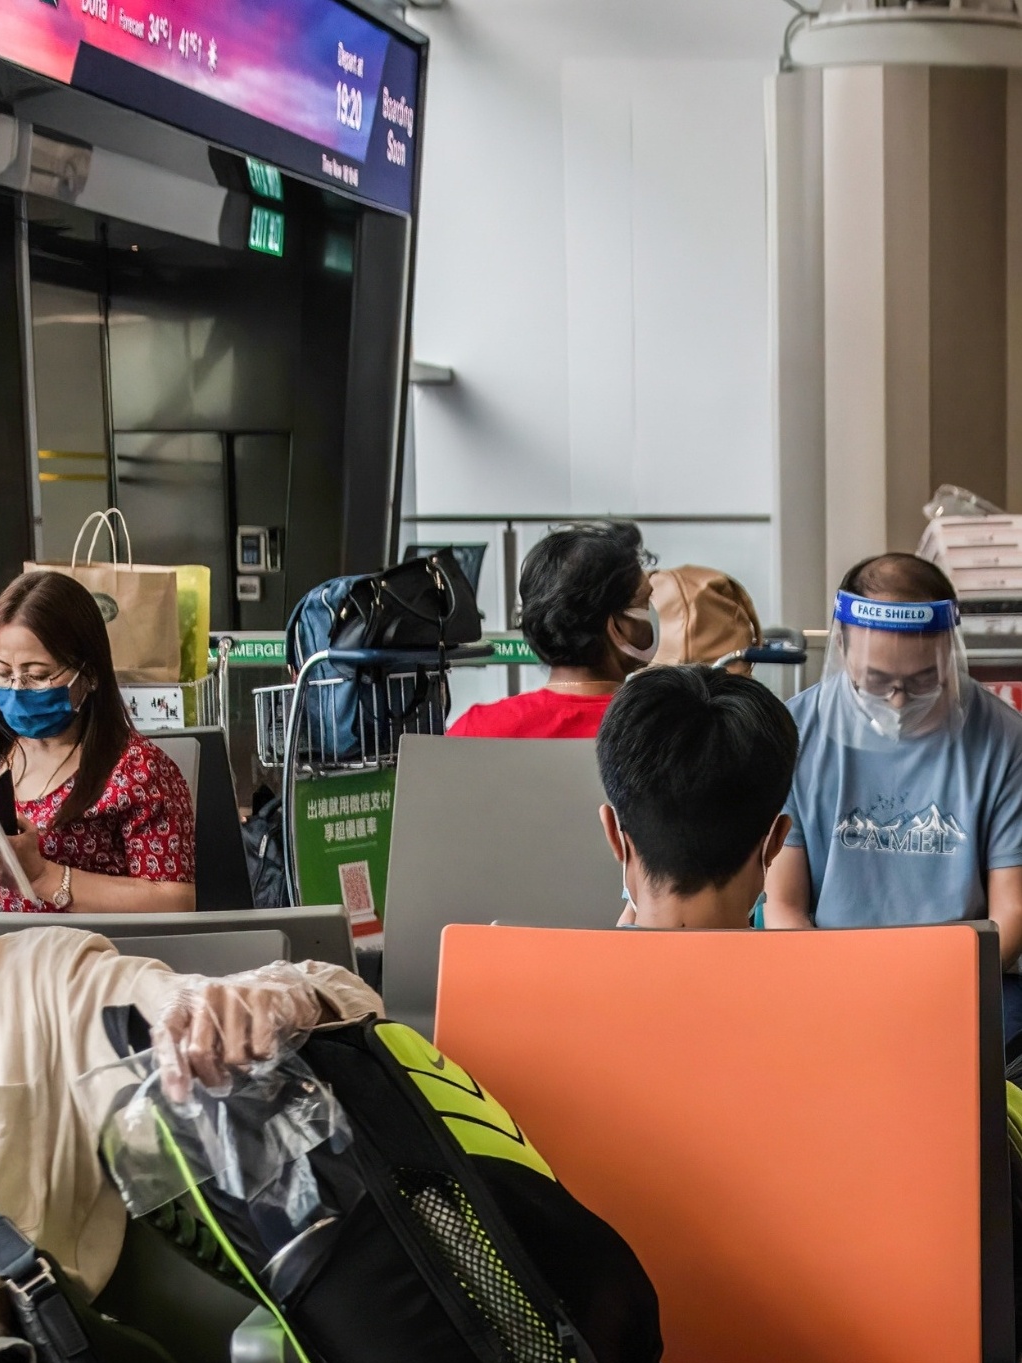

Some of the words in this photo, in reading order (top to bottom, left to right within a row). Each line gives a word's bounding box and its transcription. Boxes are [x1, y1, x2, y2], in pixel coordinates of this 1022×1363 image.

[336, 80, 363, 131] 19:20
[382, 86, 414, 138] Boarding
[386, 128, 406, 167] Soon
[858, 604, 881, 617] FACE
[885, 608, 925, 619] SHIELD
[839, 825, 956, 854] CAMEL
